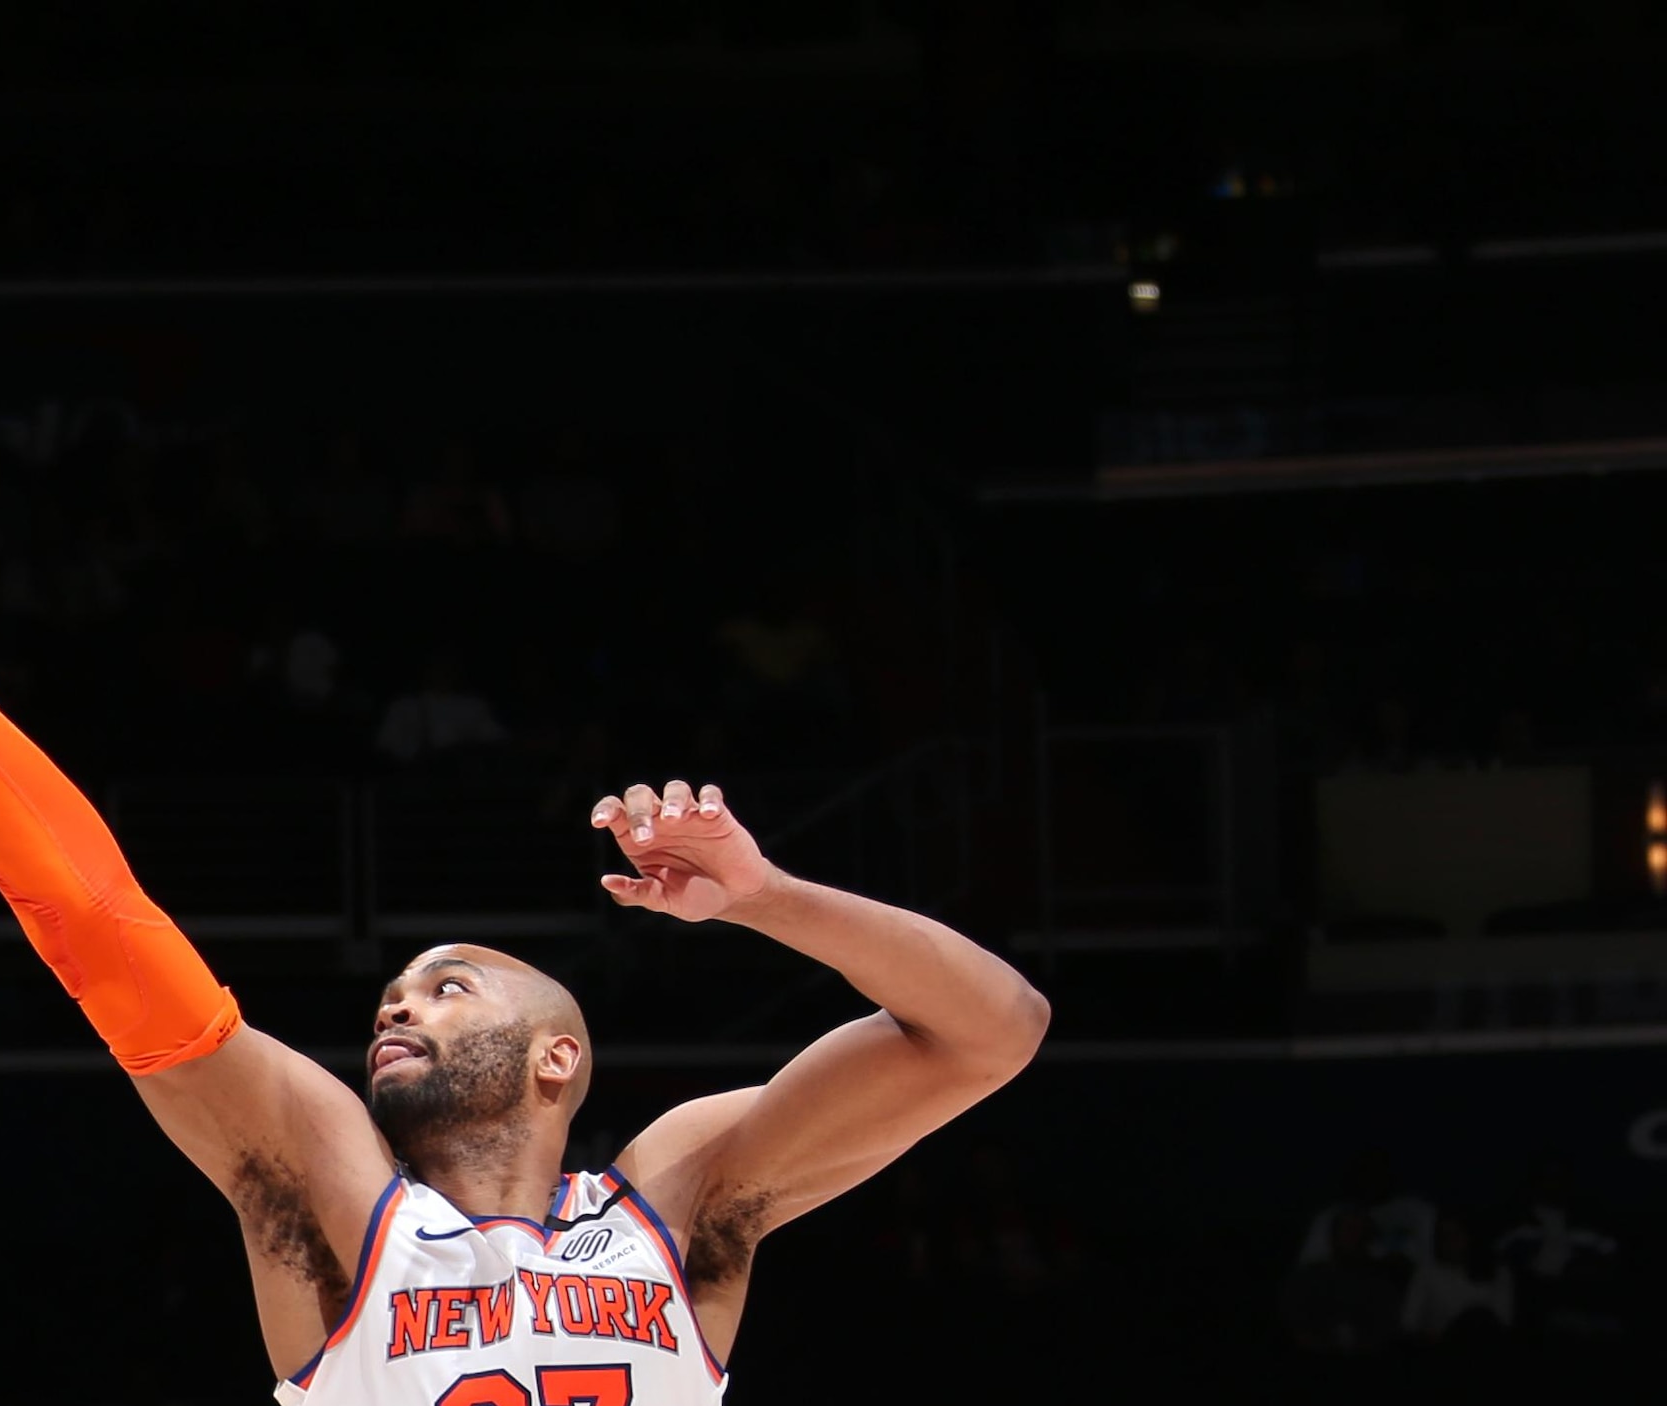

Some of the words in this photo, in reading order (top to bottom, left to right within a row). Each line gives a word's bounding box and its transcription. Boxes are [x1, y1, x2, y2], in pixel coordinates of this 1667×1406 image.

[591, 1243, 637, 1271] RESPACE
[386, 1272, 515, 1363] NEW
[516, 1265, 679, 1356] YORK
